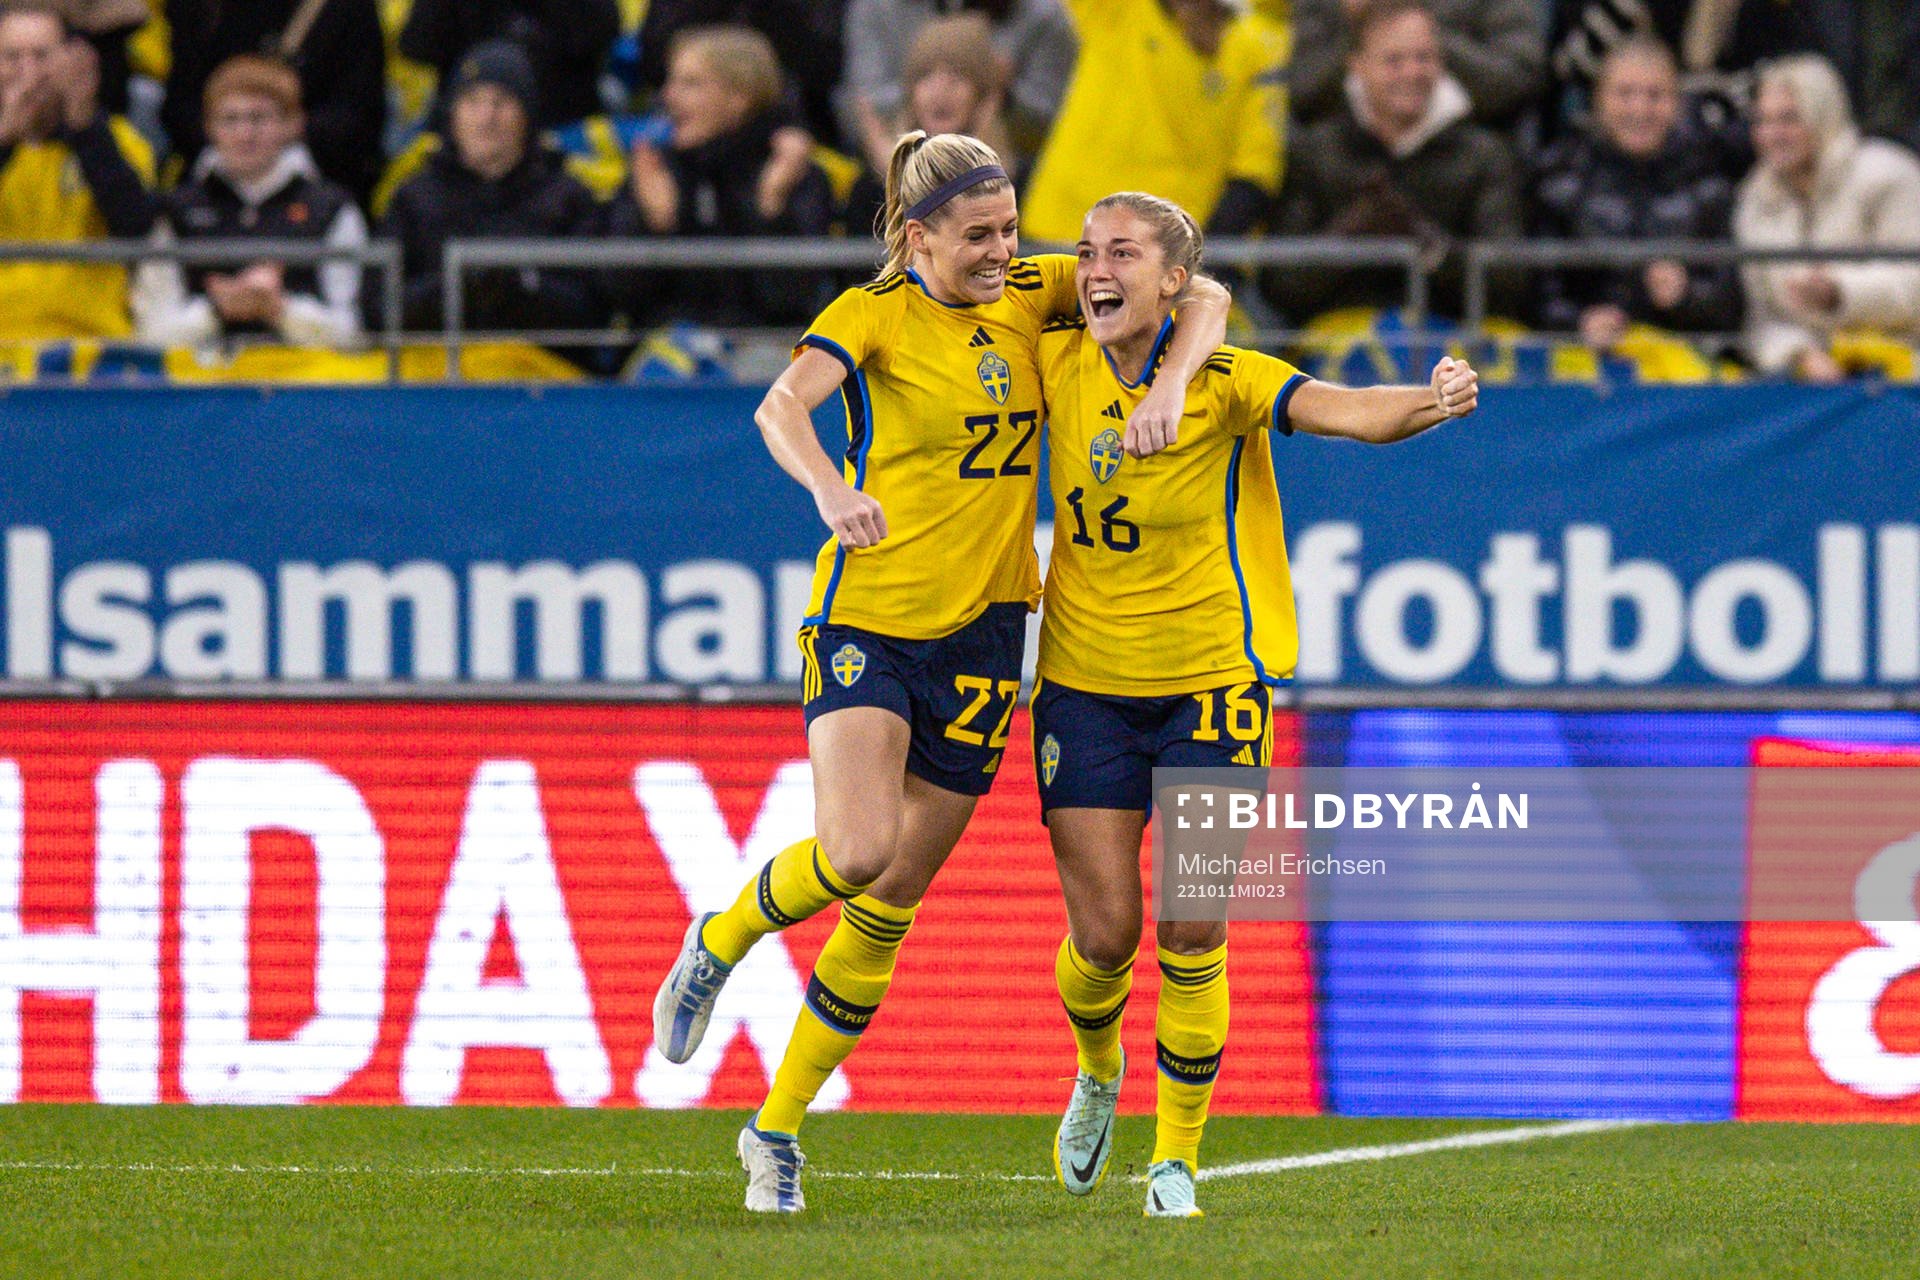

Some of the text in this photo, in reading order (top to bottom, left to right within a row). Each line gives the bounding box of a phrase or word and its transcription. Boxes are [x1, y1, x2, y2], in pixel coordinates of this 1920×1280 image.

[959, 410, 1037, 479] 22
[1066, 486, 1140, 553] 16
[6, 525, 816, 681] lsamma
[1292, 521, 1920, 684] fotboll
[944, 674, 1020, 748] 22
[1192, 682, 1262, 741] 16
[0, 758, 853, 1110] HDAX
